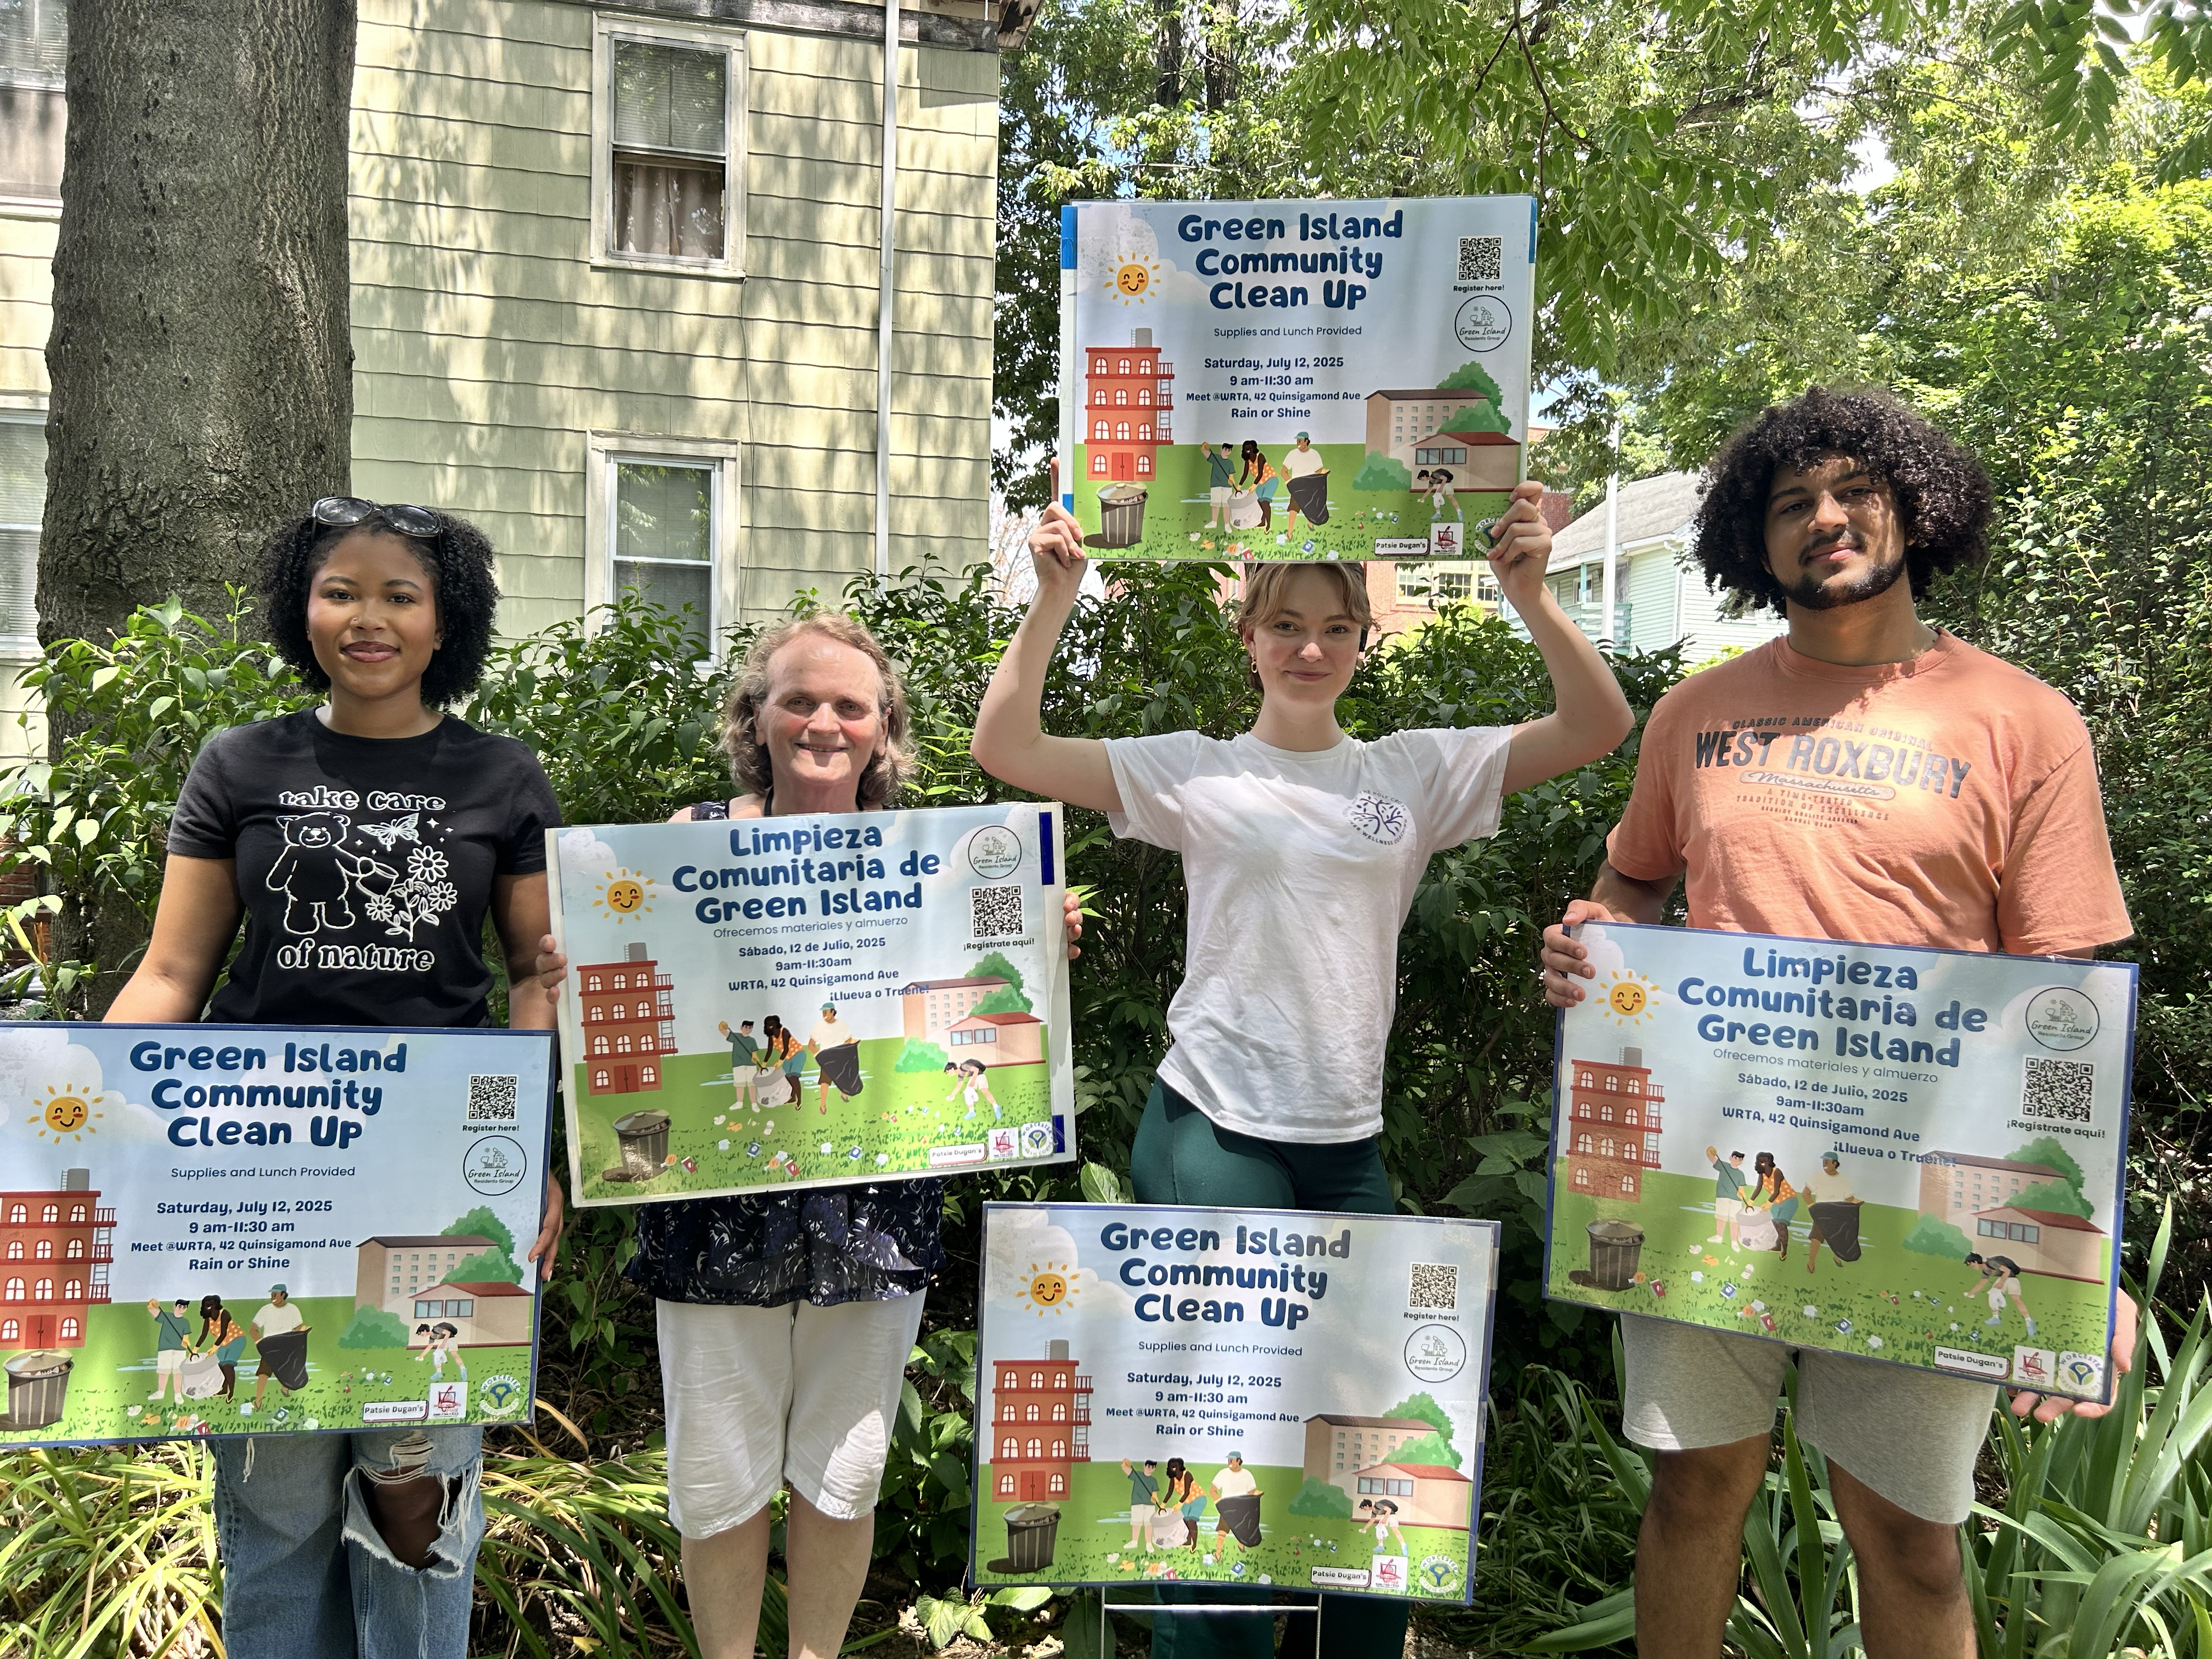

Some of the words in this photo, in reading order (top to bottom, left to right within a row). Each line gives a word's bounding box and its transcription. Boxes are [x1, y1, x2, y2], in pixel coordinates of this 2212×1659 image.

[1177, 214, 1285, 242] Green
[1300, 209, 1403, 241] Island
[1195, 245, 1383, 279] Community
[1209, 281, 1308, 309] Clean
[1323, 279, 1367, 310] Up
[1453, 284, 1484, 293] Register
[1214, 327, 1257, 338] Supplies
[1260, 327, 1280, 336] and
[1283, 326, 1313, 336] Lunch
[1317, 326, 1362, 335] Provided
[1204, 357, 1263, 371] Saturday,
[1266, 357, 1290, 370] July
[1295, 357, 1309, 369] 12,
[1313, 357, 1344, 367] 2025
[1230, 375, 1237, 386] 9
[1240, 375, 1291, 385] am-11:30
[1295, 377, 1313, 385] am
[1186, 393, 1211, 401] Meet
[1213, 393, 1251, 402] @WRTA,
[1254, 392, 1266, 400] 42
[1269, 391, 1339, 403] Quinsigamond
[1231, 407, 1257, 417] Rain
[1277, 407, 1311, 417] Shine
[1399, 541, 1426, 550] Dugan's
[1733, 717, 1786, 729] CLASSIC
[1792, 718, 1864, 732] AMERICAN
[1869, 726, 1932, 751] ORIGINAL
[1696, 731, 1780, 769] WEST
[1786, 734, 1971, 798] ROXBURY
[1748, 772, 1880, 795] Massachusetts
[279, 786, 359, 810] take
[367, 790, 446, 811] care
[1736, 795, 1794, 807] TRADITION
[1801, 803, 1814, 811] OF
[730, 824, 882, 856] Limpieza
[672, 854, 885, 893] Comunitaria
[899, 850, 940, 877] de
[695, 896, 806, 924] Green
[820, 882, 922, 916] Island
[713, 927, 778, 938] Ofrecemos
[781, 921, 843, 933] materiales
[845, 921, 852, 932] y
[855, 917, 908, 928] almuerzo
[739, 945, 787, 957] Sábado,
[790, 943, 801, 953] 12
[805, 943, 819, 952] de
[822, 939, 853, 950] Julio,
[856, 937, 885, 948] 2025
[963, 940, 1011, 951] ¡Regístrate
[1012, 937, 1034, 947] aquí!
[278, 938, 315, 969] of
[318, 943, 435, 971] nature
[775, 957, 851, 971] 9am-11:30am
[1743, 947, 1917, 990] Limpieza
[729, 979, 768, 991] WRTA,
[771, 978, 786, 988] 42
[789, 970, 874, 988] Quinsigamond
[878, 970, 899, 979] Ave
[830, 991, 871, 1001] ¡Llueva
[1678, 977, 1916, 1027] Comunitaria
[1934, 1000, 1988, 1032] de
[1697, 1014, 1819, 1051] Green
[1836, 1026, 1960, 1068] Island
[129, 1041, 266, 1071] Green
[284, 1042, 407, 1073] Island
[1713, 1048, 1783, 1065] Ofrecemos
[1787, 1058, 1858, 1074] materiales
[1862, 1066, 1869, 1077] y
[1873, 1066, 1938, 1082] almuerzo
[1738, 1073, 1790, 1090] Sábado,
[1795, 1080, 1807, 1090] 12
[1811, 1081, 1827, 1093] de
[1831, 1084, 1867, 1099] Julio,
[1872, 1088, 1908, 1102] 2025
[151, 1079, 382, 1116] Community
[1776, 1096, 1864, 1116] 9am-11:30am
[167, 1116, 291, 1147] Clean
[310, 1115, 362, 1149] Up
[462, 1124, 496, 1133] Register
[1722, 1107, 1764, 1122] WRTA,
[1769, 1113, 1785, 1124] 42
[1789, 1115, 1889, 1138] Quinsigamond
[1893, 1129, 1920, 1142] Ave
[2007, 1119, 2072, 1134] ¡Regístrate
[2074, 1128, 2105, 1138] aquí!
[1833, 1141, 1883, 1158] ¡Llueva
[1887, 1150, 1896, 1159] o
[171, 1167, 226, 1180] Supplies
[230, 1167, 256, 1177] and
[259, 1167, 296, 1176] Lunch
[301, 1166, 355, 1176] Provided
[468, 1169, 490, 1178] Green
[493, 1169, 521, 1177] Island
[157, 1201, 232, 1216] Saturday,
[236, 1201, 267, 1216] July
[272, 1201, 290, 1214] 12,
[295, 1200, 332, 1211] 2025
[189, 1222, 198, 1233] 9
[202, 1221, 267, 1233] am-11:30
[271, 1222, 294, 1232] am
[131, 1242, 163, 1251] Meet
[166, 1241, 216, 1251] @WRTA,
[219, 1240, 235, 1250] 42
[238, 1238, 326, 1251] Quinsigamond
[329, 1238, 351, 1248] Ave
[1101, 1222, 1220, 1251] Green
[1236, 1225, 1351, 1259] Island
[189, 1257, 223, 1270] Rain
[227, 1260, 244, 1269] or
[247, 1256, 290, 1268] Shine
[1119, 1257, 1328, 1299] Community
[1134, 1293, 1244, 1323] Clean
[1261, 1297, 1308, 1330] Up
[1139, 1341, 1186, 1353] Supplies
[1190, 1343, 1212, 1351] and
[1216, 1344, 1249, 1353] Lunch
[1252, 1345, 1302, 1356] Provided
[1938, 1351, 1965, 1361] Patsie
[1966, 1356, 2003, 1368] Dugan's
[482, 1374, 521, 1392] WORCESTER
[1127, 1372, 1192, 1386] Saturday,
[1196, 1374, 1223, 1387] July
[1228, 1375, 1243, 1386] 12,
[1248, 1376, 1282, 1387] 2025
[1155, 1391, 1163, 1401] 9
[1167, 1392, 1223, 1403] am-11:30
[1227, 1395, 1248, 1403] am
[392, 1404, 424, 1414] Dugan's
[1106, 1408, 1133, 1416] Meet
[1138, 1408, 1178, 1418] @WRTA,
[1182, 1409, 1195, 1418] 42
[1198, 1409, 1276, 1421] Quinsigamond
[1279, 1413, 1299, 1422] Ave
[1156, 1424, 1185, 1435] Rain
[1189, 1427, 1204, 1435] or
[1207, 1425, 1244, 1436] Shine
